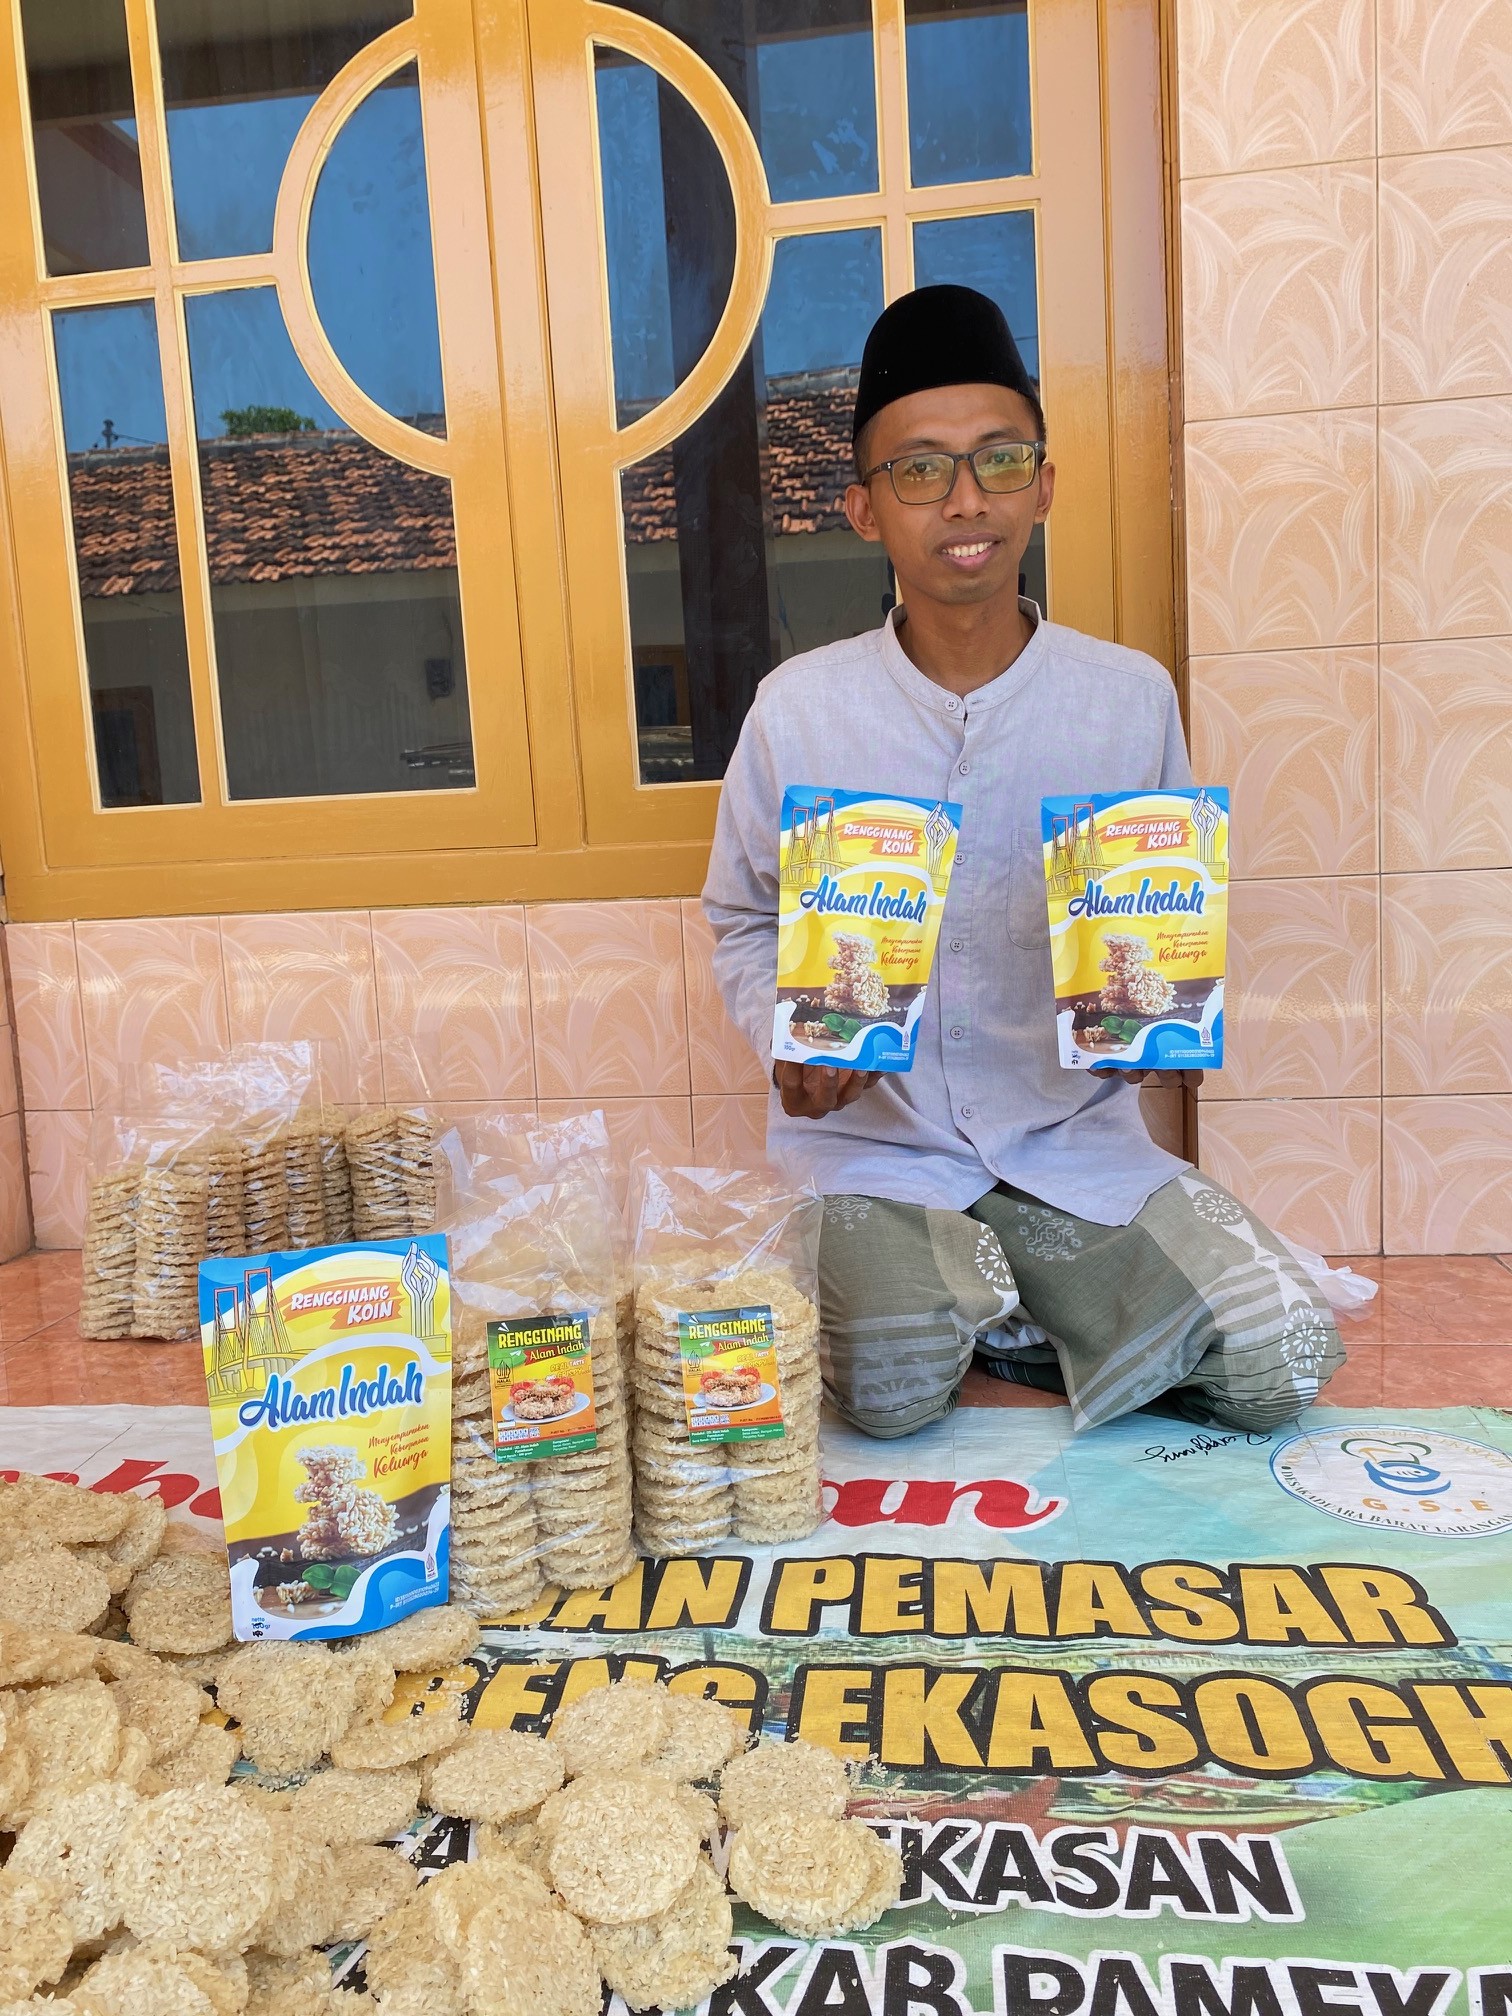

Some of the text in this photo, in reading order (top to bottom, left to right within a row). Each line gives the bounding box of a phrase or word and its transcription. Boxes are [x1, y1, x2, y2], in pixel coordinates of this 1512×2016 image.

[843, 823, 913, 841] RENGGINANG
[1105, 821, 1180, 837] RENGGINANG
[881, 838, 914, 854] KOIN
[1147, 832, 1183, 849] KOIN
[1158, 947, 1207, 963] Keluarga
[291, 1285, 390, 1310] RENGGINANG
[347, 1300, 392, 1325] KOIN
[498, 1324, 582, 1349] RENGGINANG
[688, 1318, 766, 1340] RENGGINANG
[529, 1341, 586, 1361] Alam Indah
[718, 1334, 769, 1352] Alam Indah
[373, 1449, 428, 1478] Keluarga
[478, 1552, 1458, 1648] AN PEMASAR
[865, 1820, 1296, 1914] KASAN
